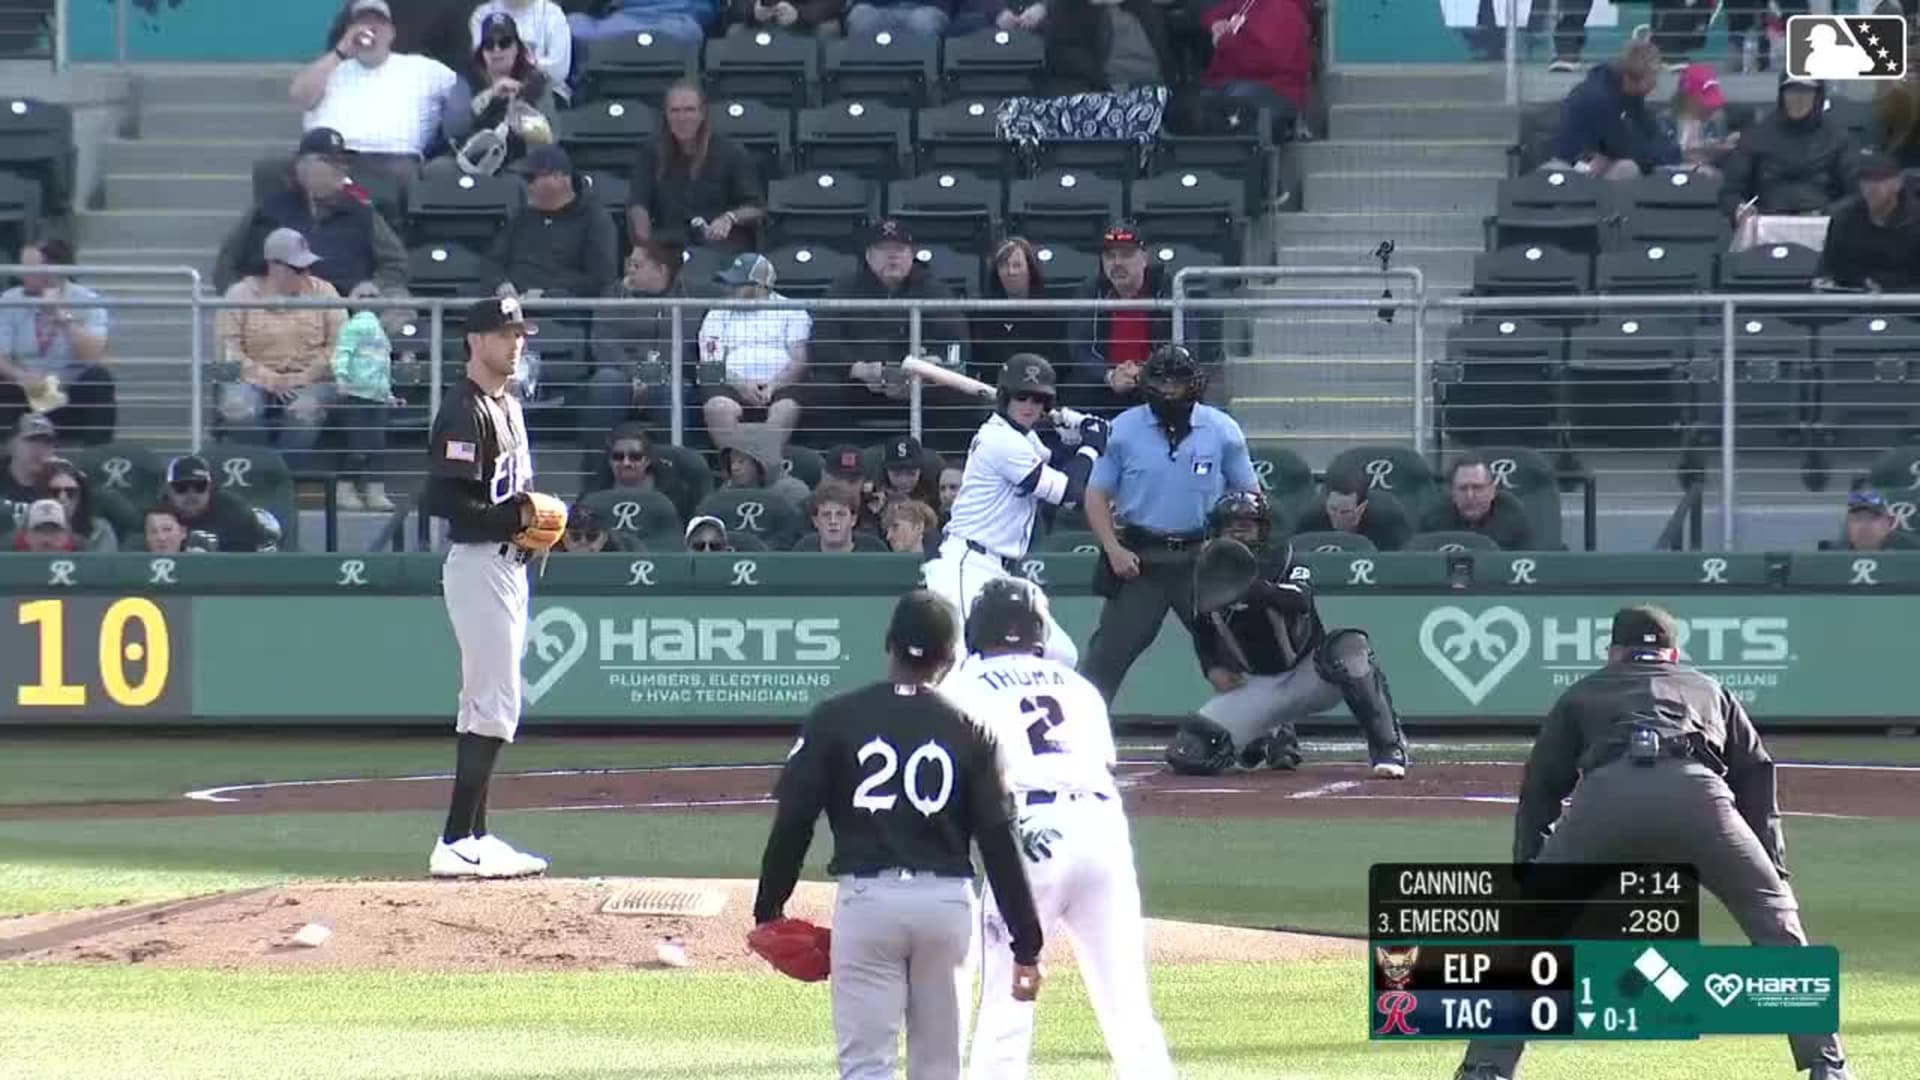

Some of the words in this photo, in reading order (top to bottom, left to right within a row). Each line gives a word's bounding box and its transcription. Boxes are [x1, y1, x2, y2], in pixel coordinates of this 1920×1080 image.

[897, 442, 907, 457] S
[18, 596, 170, 706] 10
[647, 690, 691, 701] HVAC
[695, 690, 809, 702] TECHNICIANS
[709, 673, 831, 686] ELECTRICIANS
[1019, 695, 1070, 756] 2
[853, 736, 954, 817] 20
